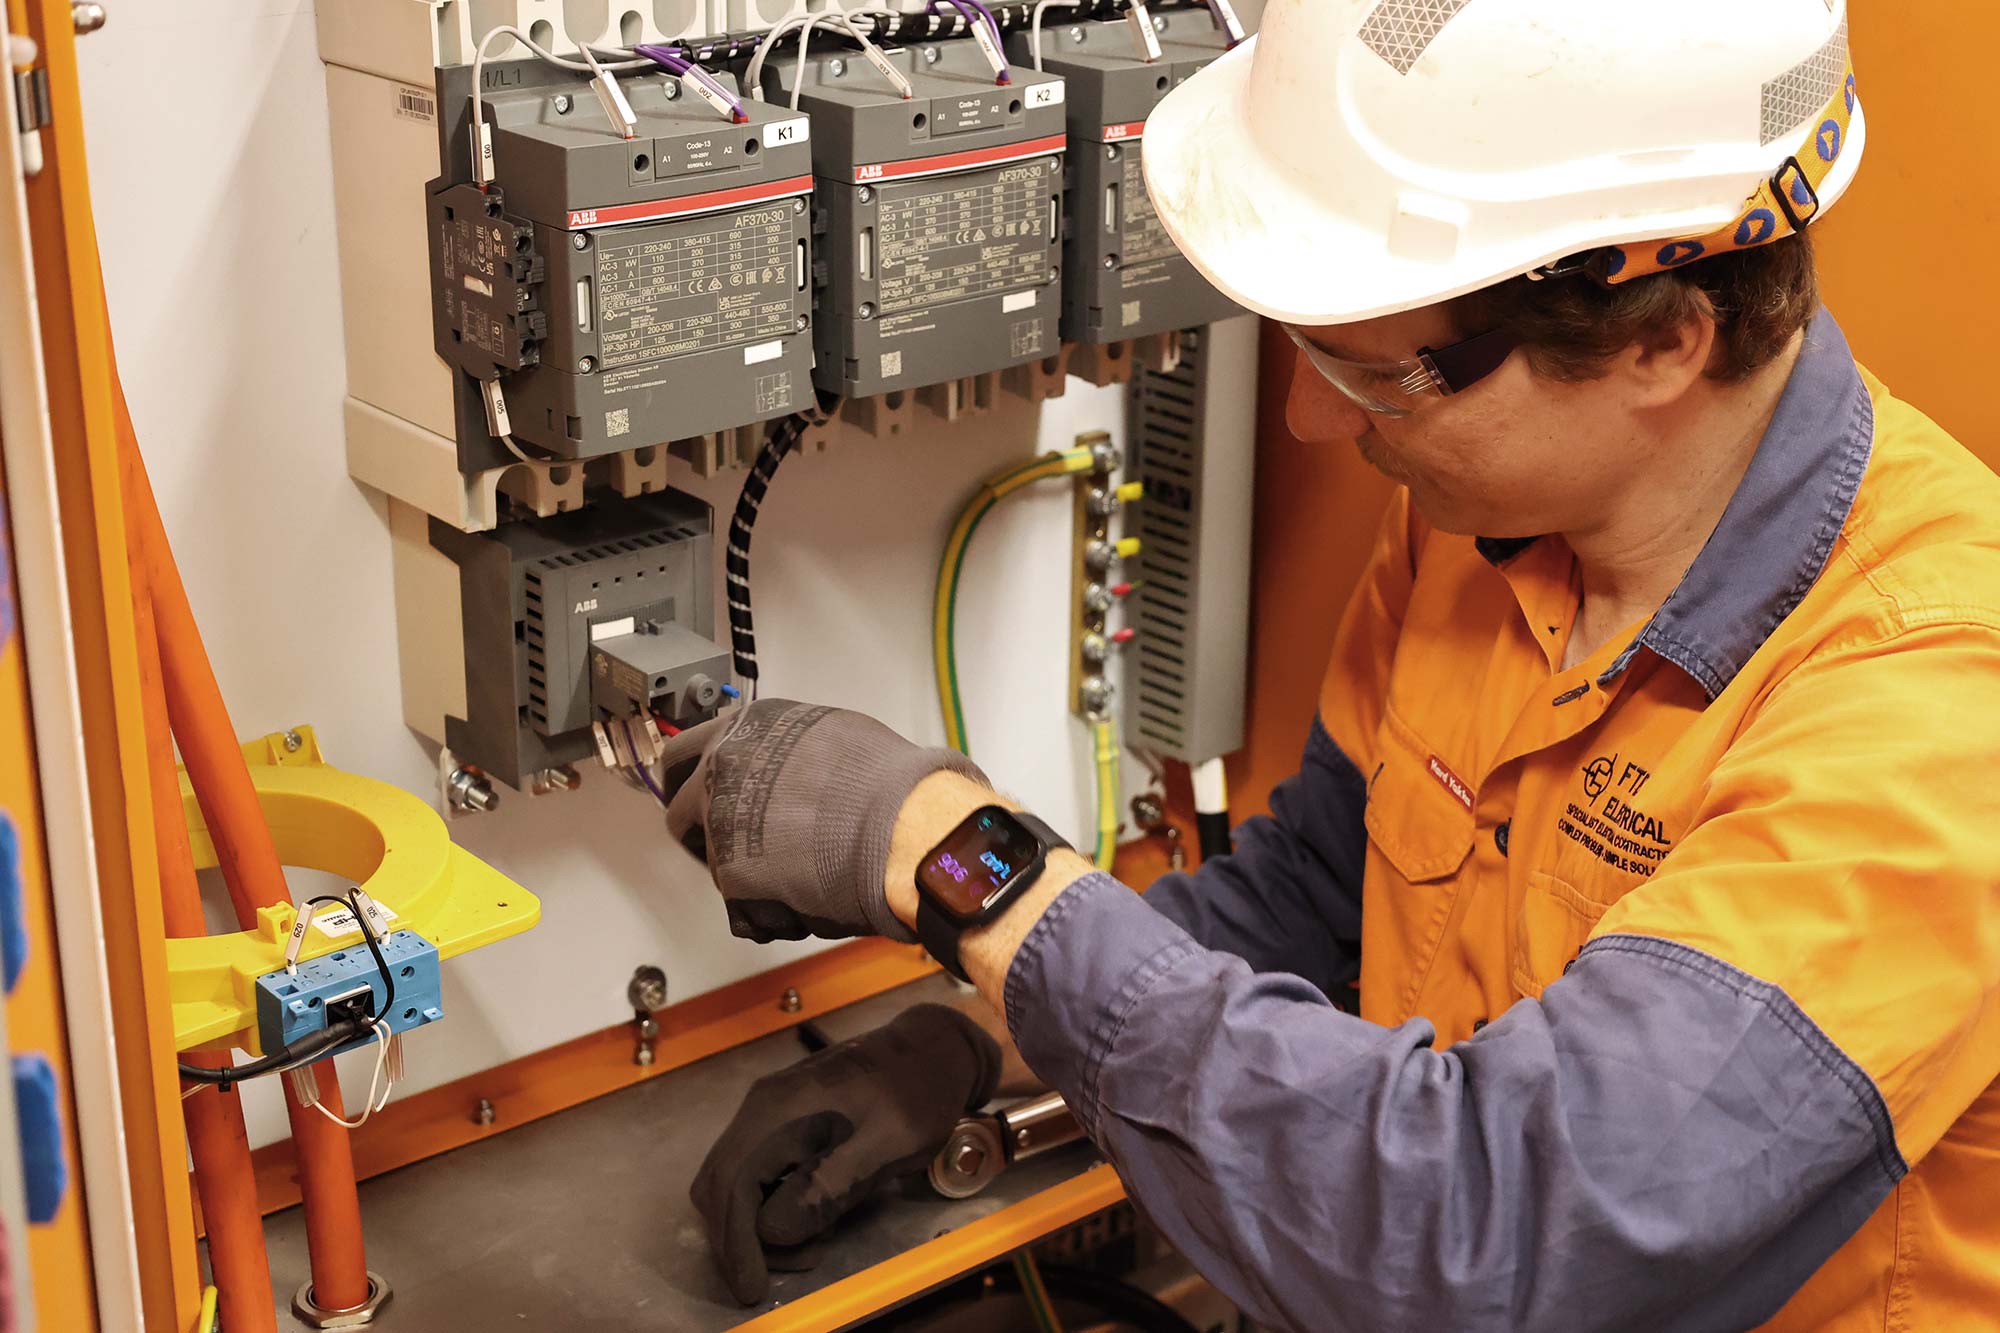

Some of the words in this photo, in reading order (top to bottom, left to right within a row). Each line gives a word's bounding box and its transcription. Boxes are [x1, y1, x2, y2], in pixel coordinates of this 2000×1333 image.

[698, 86, 713, 100] 002
[1036, 89, 1050, 102] K2
[778, 126, 793, 141] K1
[686, 140, 712, 150] Code-13
[662, 156, 671, 164] A1
[859, 165, 883, 179] ABB
[998, 166, 1042, 182] AF370-30
[571, 210, 598, 226] ABB
[735, 210, 784, 228] AF370-30
[628, 248, 634, 256] V
[644, 242, 672, 254] 220-240
[684, 236, 711, 247] 380-415
[729, 231, 742, 240] 690
[765, 224, 781, 234] 1000
[600, 262, 618, 272] AC-3
[625, 258, 638, 268] kW
[652, 254, 664, 263] 110
[692, 248, 704, 257] 200
[729, 242, 742, 251] 315
[766, 235, 779, 244] 200
[601, 273, 618, 282] AC-3
[628, 270, 634, 278] A
[652, 265, 665, 274] 370
[692, 258, 704, 268] 370
[730, 252, 742, 261] 315
[768, 246, 779, 254] 141
[601, 284, 618, 294] AC-1
[628, 282, 635, 290] A
[652, 276, 665, 285] 600
[692, 270, 704, 278] 600
[768, 256, 780, 265] 400
[604, 332, 628, 342] Voltage
[648, 322, 674, 334] 200-208
[686, 316, 713, 327] 220-240
[604, 342, 628, 354] HP-3ph
[630, 340, 640, 348] HP
[654, 336, 666, 344] 125
[604, 352, 638, 366] Instruction
[496, 400, 505, 414] 005
[574, 599, 598, 614] ABB
[366, 906, 378, 919] 025
[294, 922, 305, 940] 029
